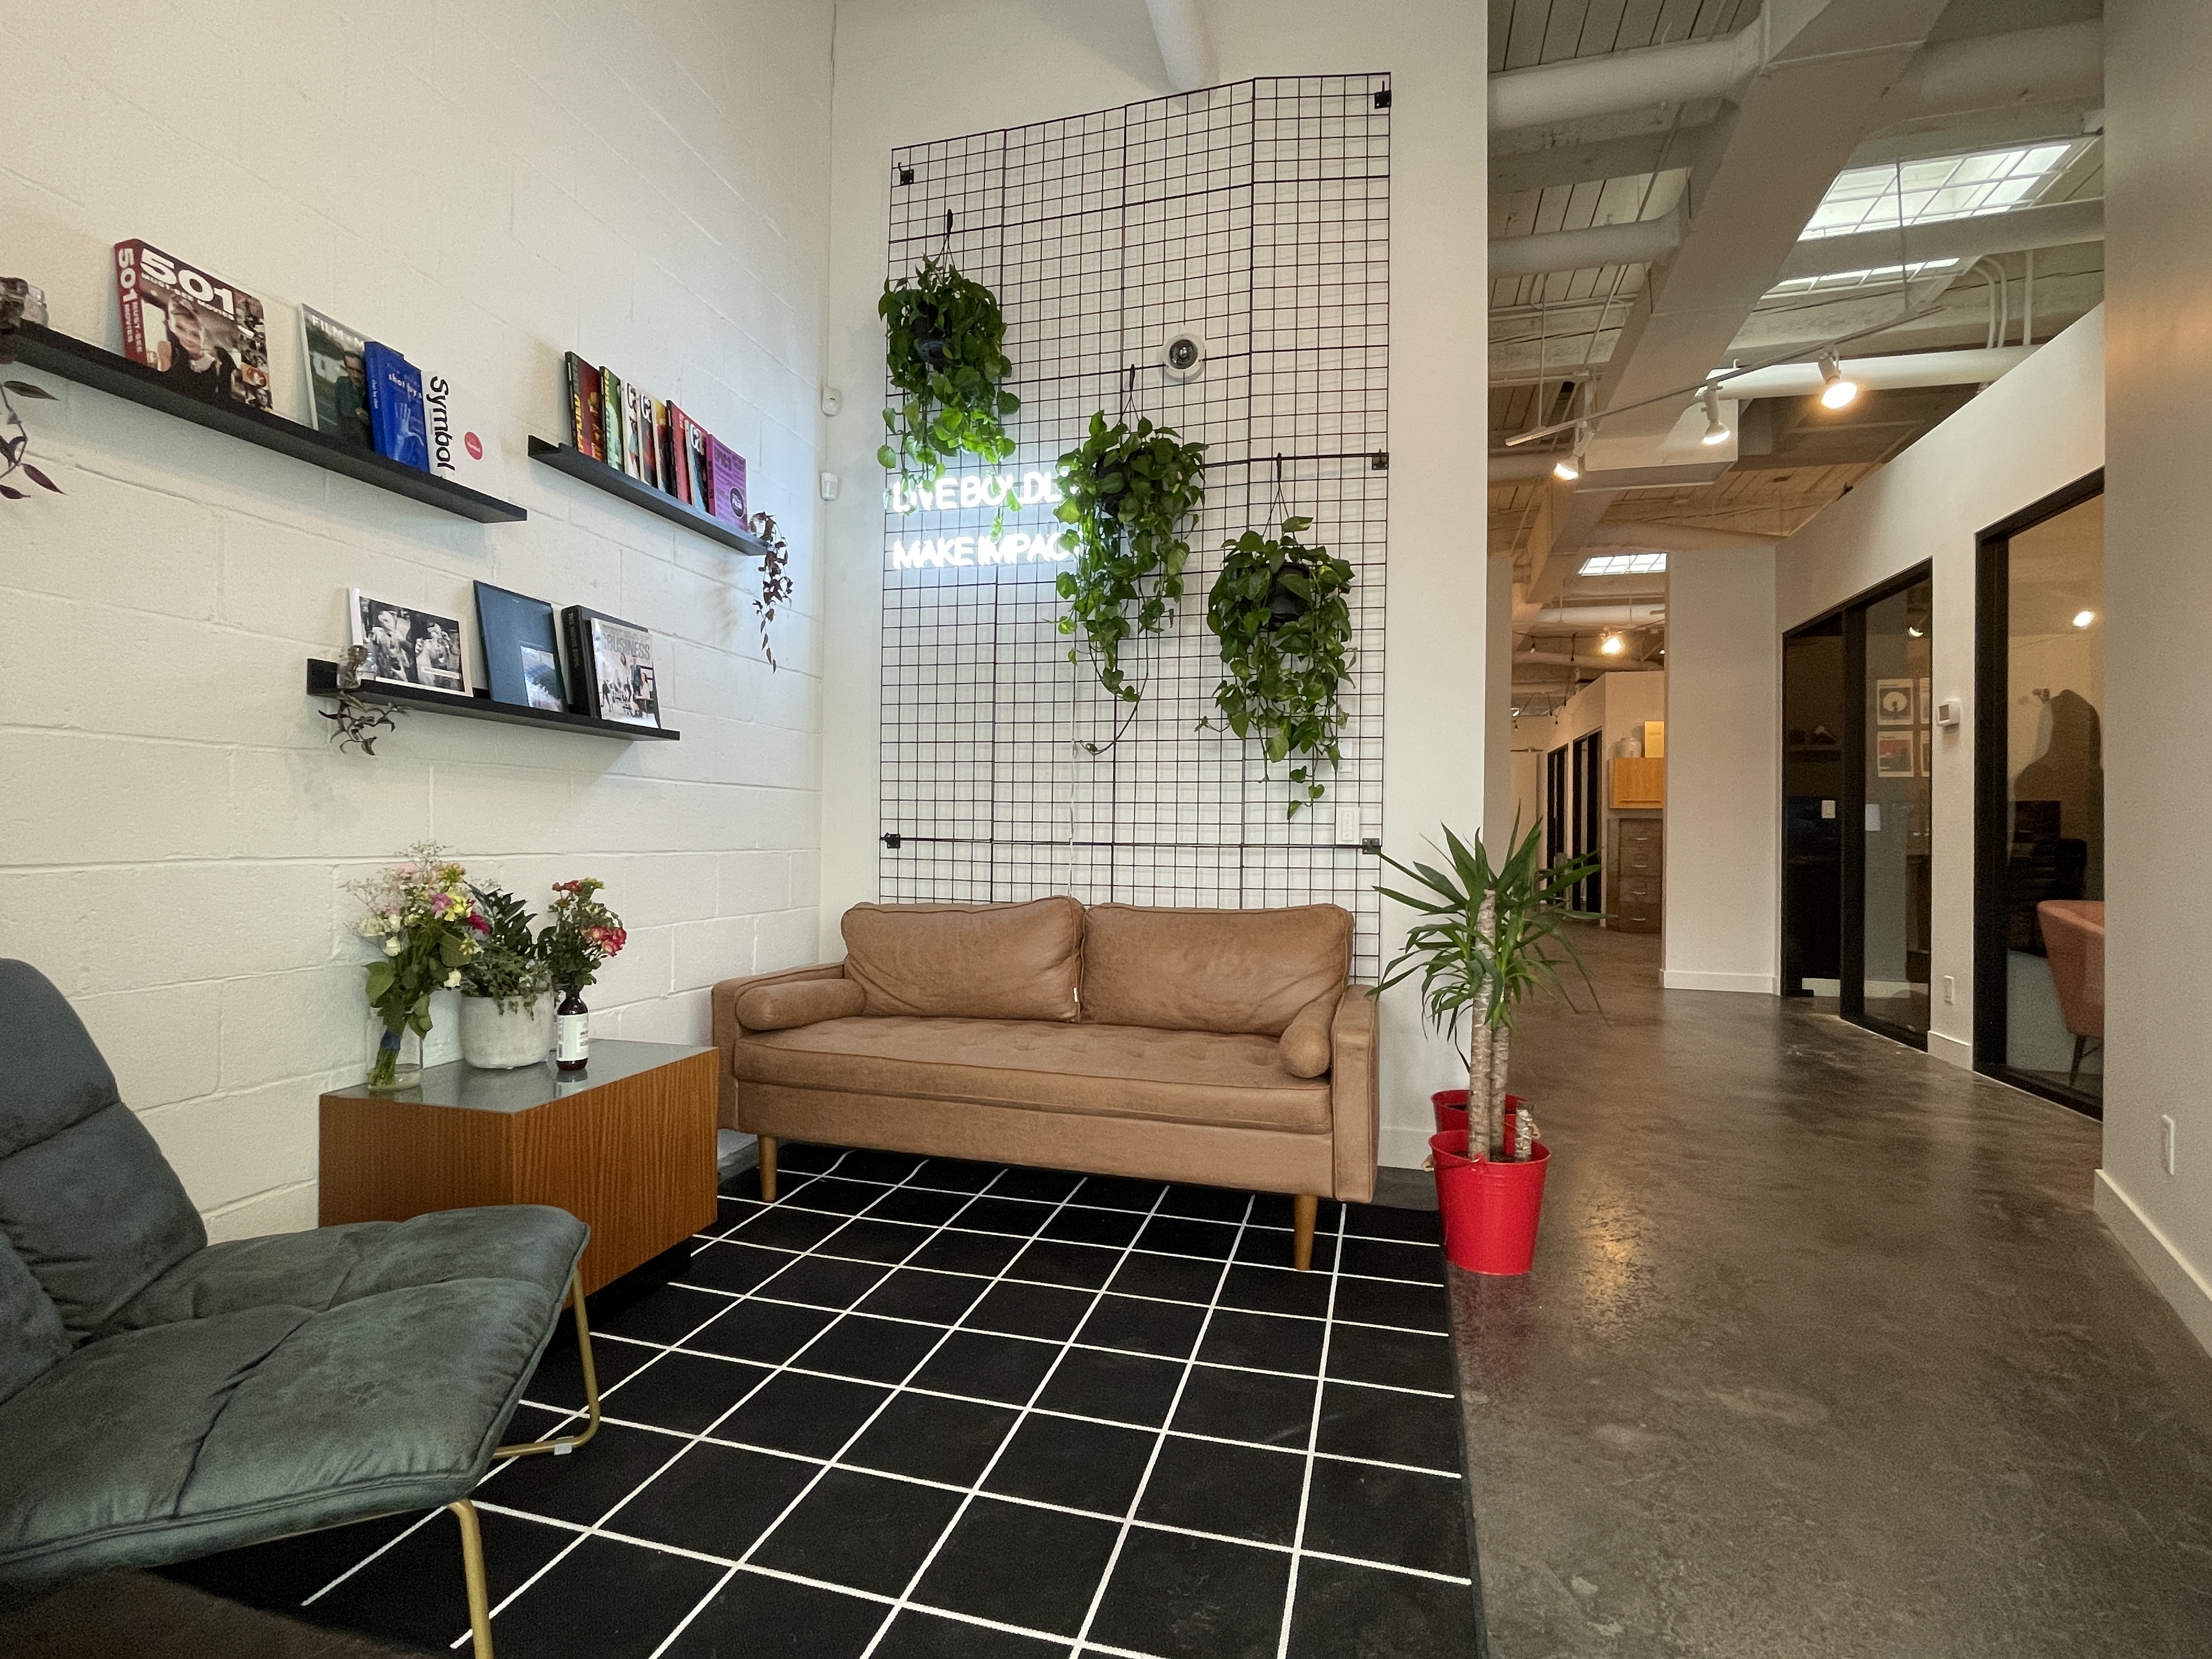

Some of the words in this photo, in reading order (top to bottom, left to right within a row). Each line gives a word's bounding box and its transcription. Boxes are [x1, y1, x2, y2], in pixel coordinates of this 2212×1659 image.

[119, 248, 138, 302] 501
[140, 248, 235, 315] 501
[197, 300, 235, 321] MOVIES
[426, 376, 455, 471] Symbol
[960, 470, 1076, 509] BOLDL
[893, 536, 974, 570] MAKE
[978, 532, 1081, 566] IMPAC
